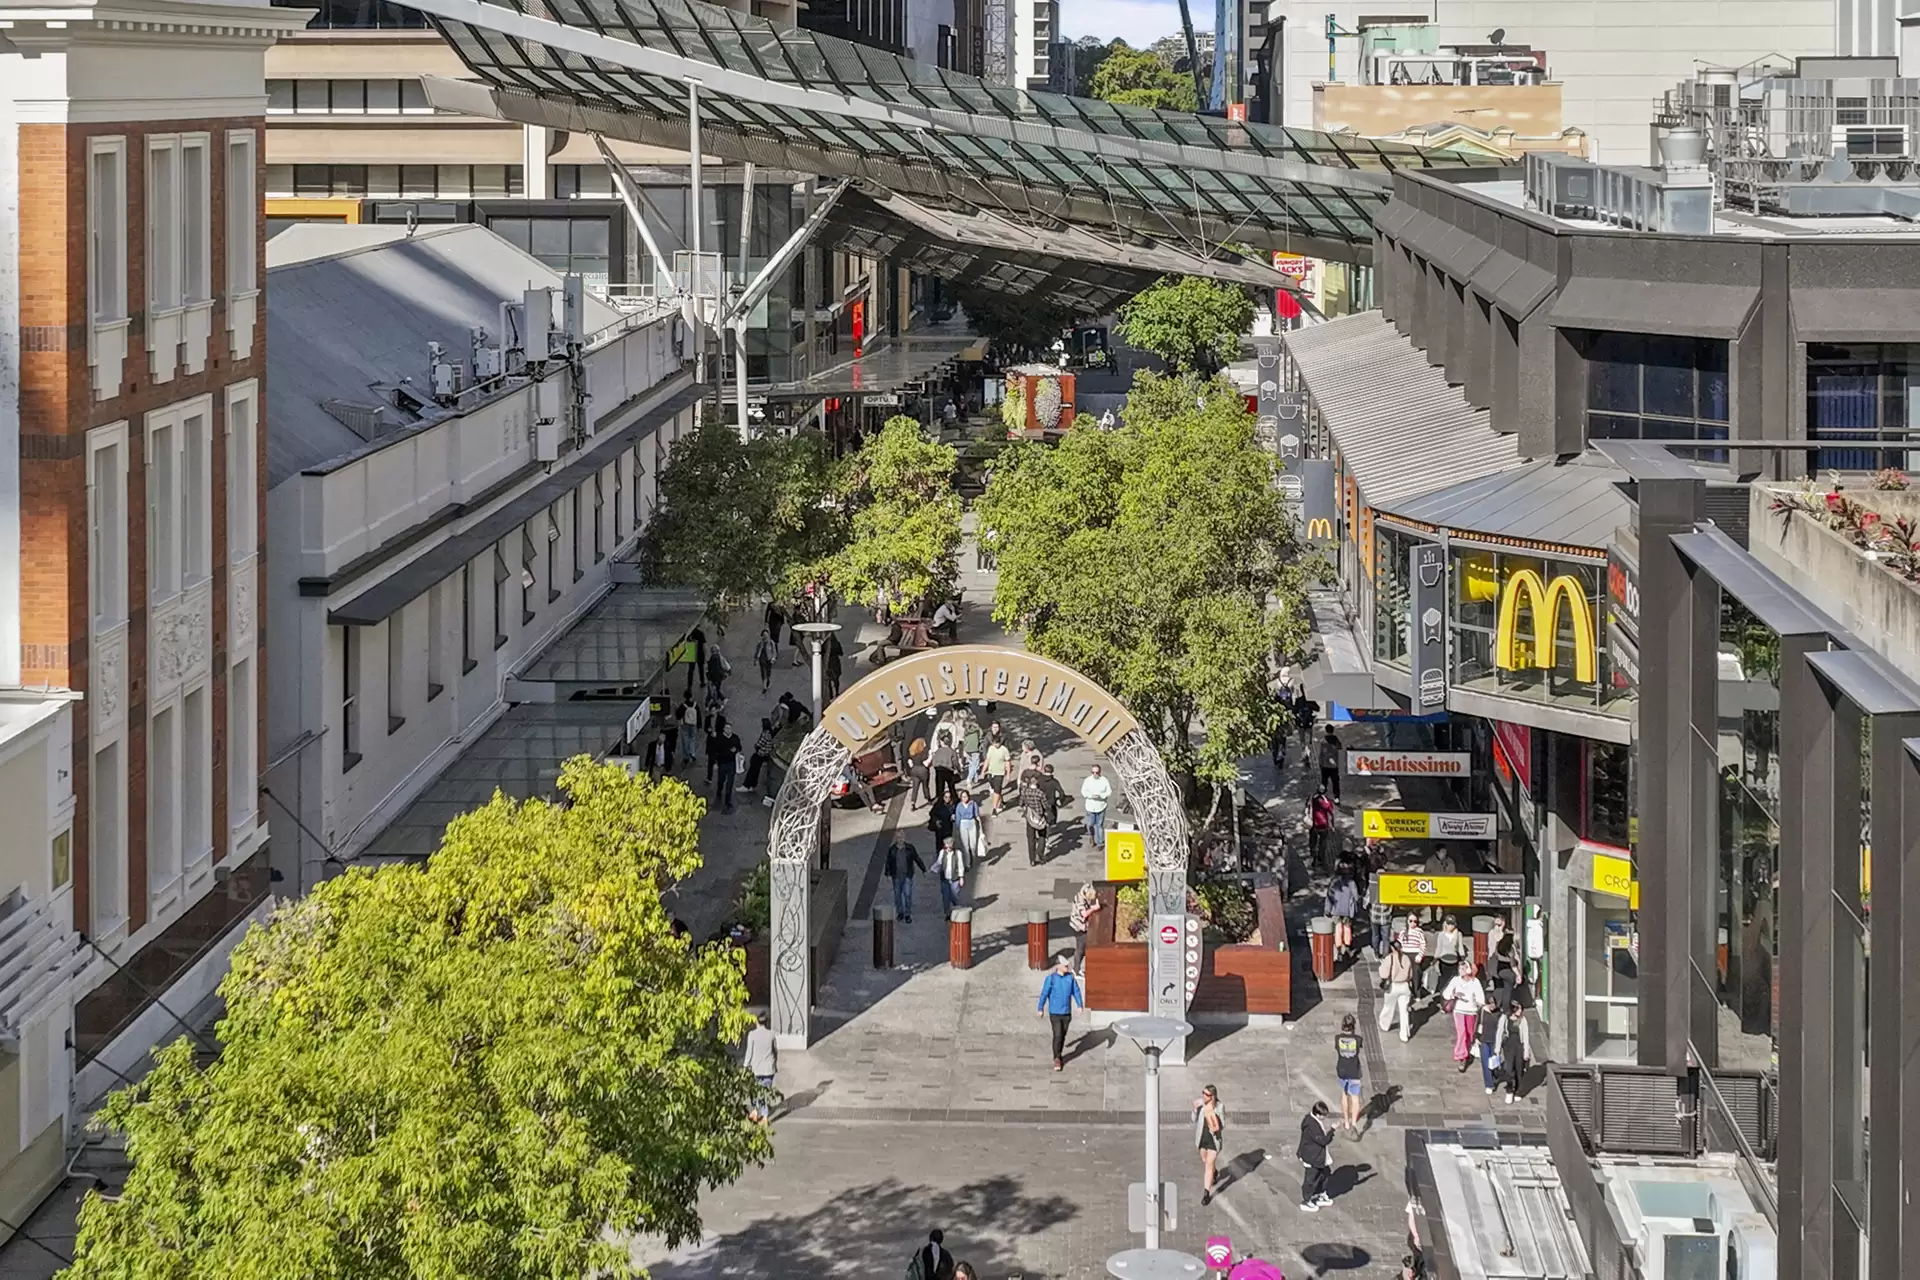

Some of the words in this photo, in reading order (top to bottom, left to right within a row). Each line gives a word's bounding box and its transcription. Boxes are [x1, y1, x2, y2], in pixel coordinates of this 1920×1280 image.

[836, 672, 936, 742] Queen
[938, 660, 1050, 705] Street
[1047, 680, 1122, 744] Mall
[1356, 754, 1462, 774] Gelatissimo
[1385, 818, 1427, 826] CURRENCY
[1408, 879, 1438, 894] SOL
